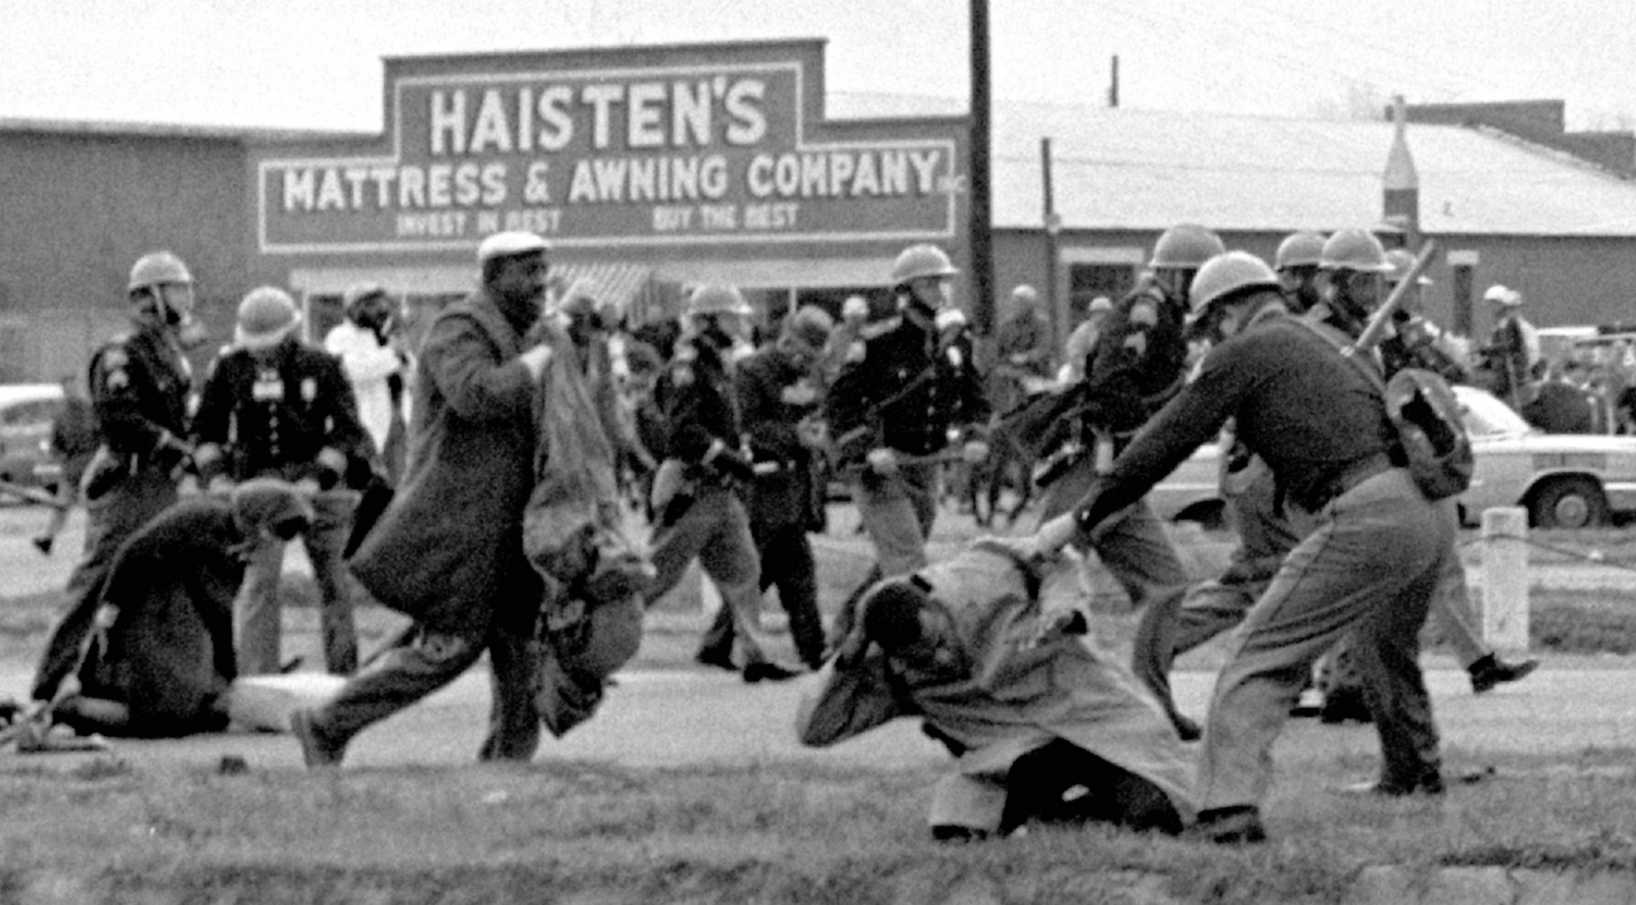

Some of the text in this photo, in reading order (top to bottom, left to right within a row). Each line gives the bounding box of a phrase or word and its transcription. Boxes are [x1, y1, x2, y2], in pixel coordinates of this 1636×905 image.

[431, 77, 766, 153] HAISTEN'S
[284, 165, 508, 210] MATTRESS
[524, 163, 550, 202] &
[569, 156, 727, 201] AWNING
[748, 150, 940, 195] COMPANY
[397, 212, 466, 236] INVEST
[478, 210, 499, 232] IN
[653, 202, 798, 230] BUY THE BEST
